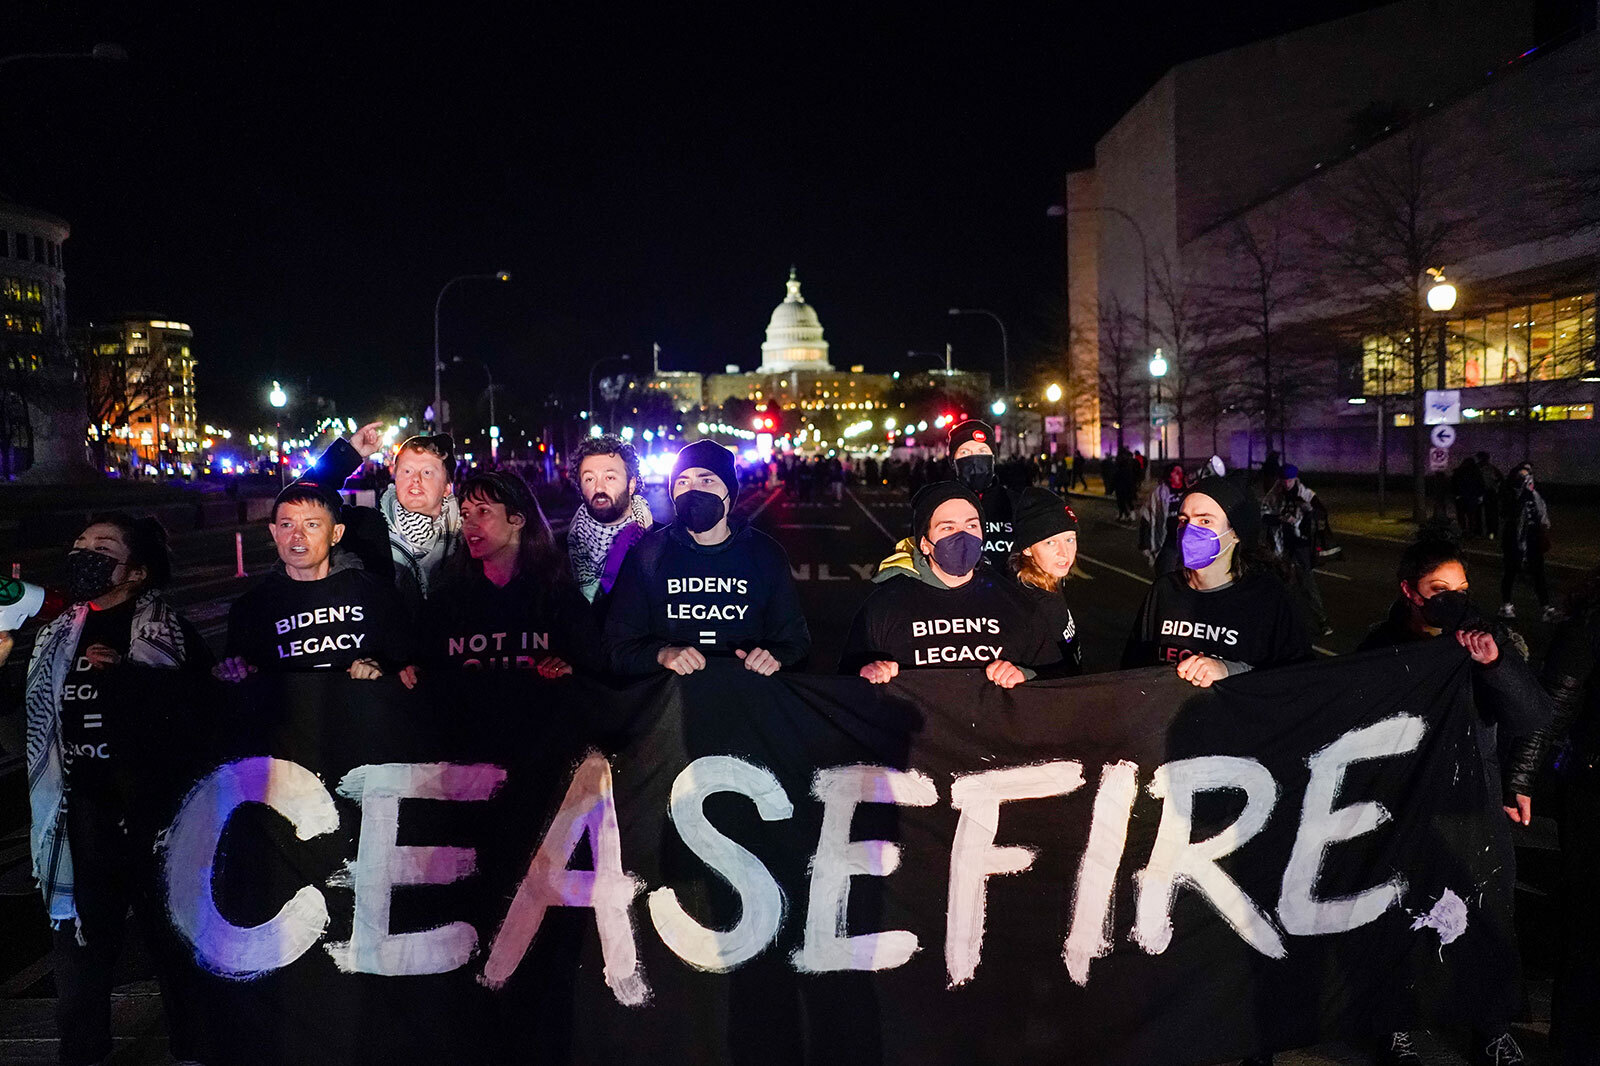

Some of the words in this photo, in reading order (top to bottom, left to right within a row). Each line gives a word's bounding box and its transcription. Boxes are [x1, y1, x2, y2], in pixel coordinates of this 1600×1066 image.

[667, 577, 748, 594] BIDEN'S
[275, 605, 364, 635] BIDEN'S
[667, 603, 749, 620] LEGACY
[912, 617, 1000, 637] BIDEN'S
[1161, 620, 1239, 645] BIDEN'S
[277, 634, 365, 659] LEGACY
[448, 632, 507, 656] NOT
[521, 632, 549, 650] IN
[914, 645, 1003, 666] LEGACY
